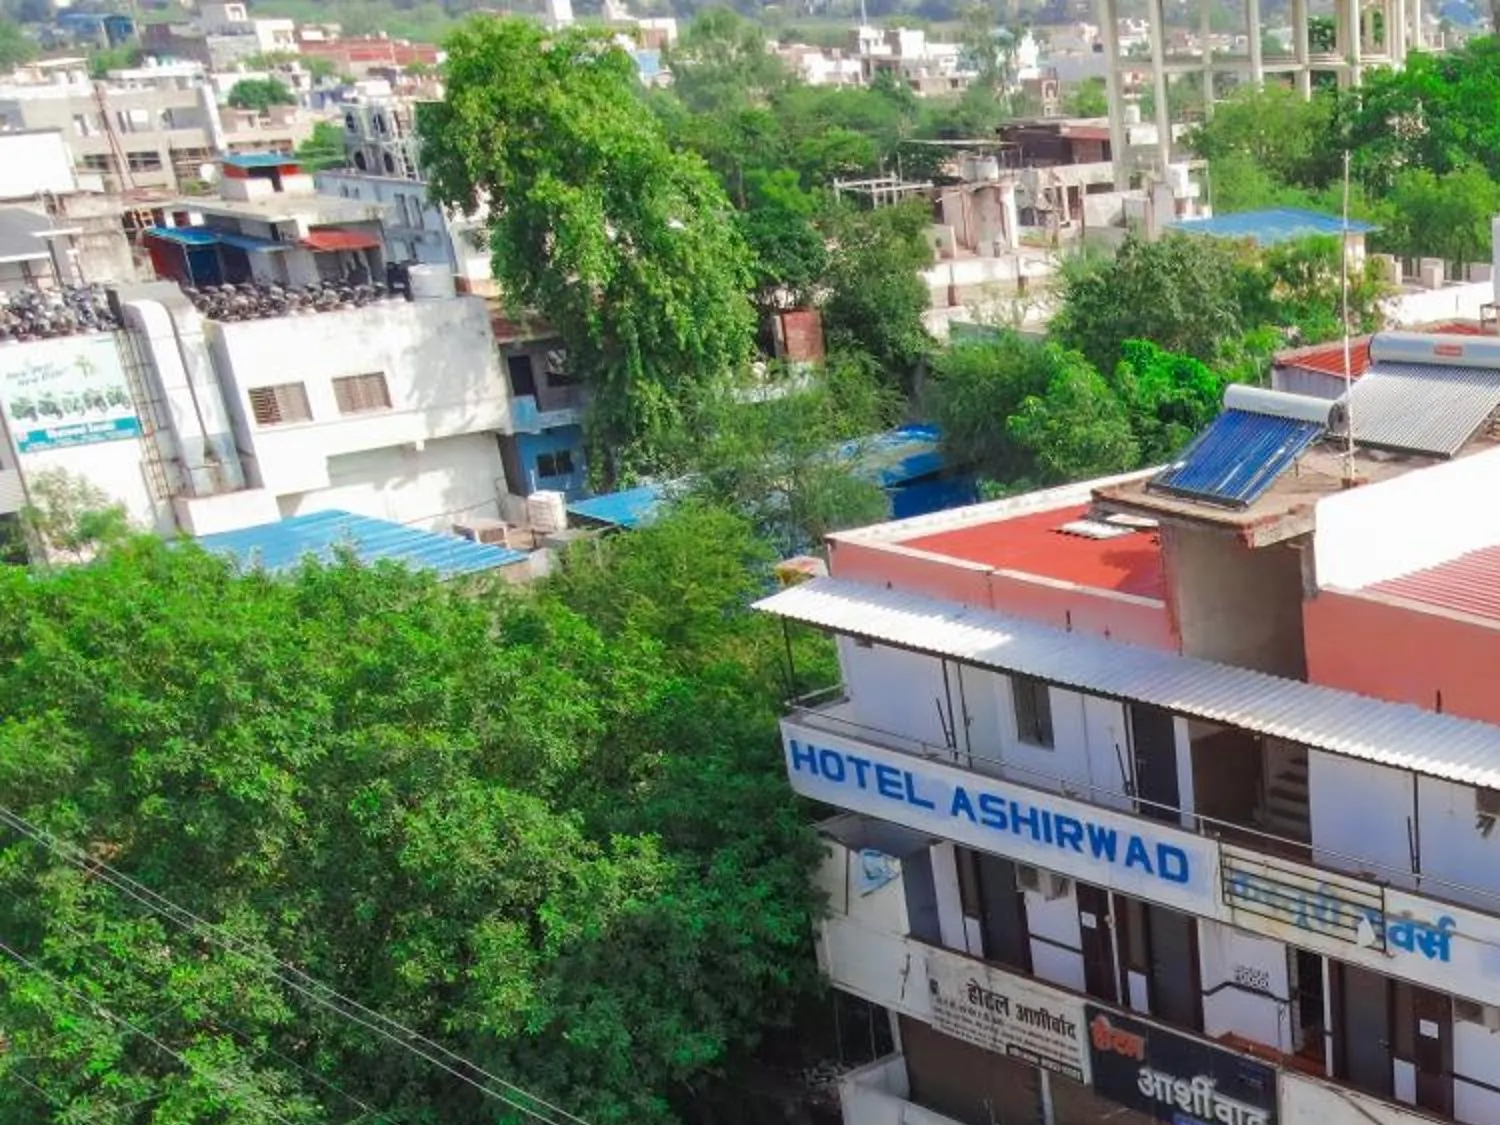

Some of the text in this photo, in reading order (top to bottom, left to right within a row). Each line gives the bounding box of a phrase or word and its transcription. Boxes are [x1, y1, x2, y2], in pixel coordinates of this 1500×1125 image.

[789, 739, 1189, 883] HOTEL ASHIRWAD
[966, 978, 1009, 1017] होटल
